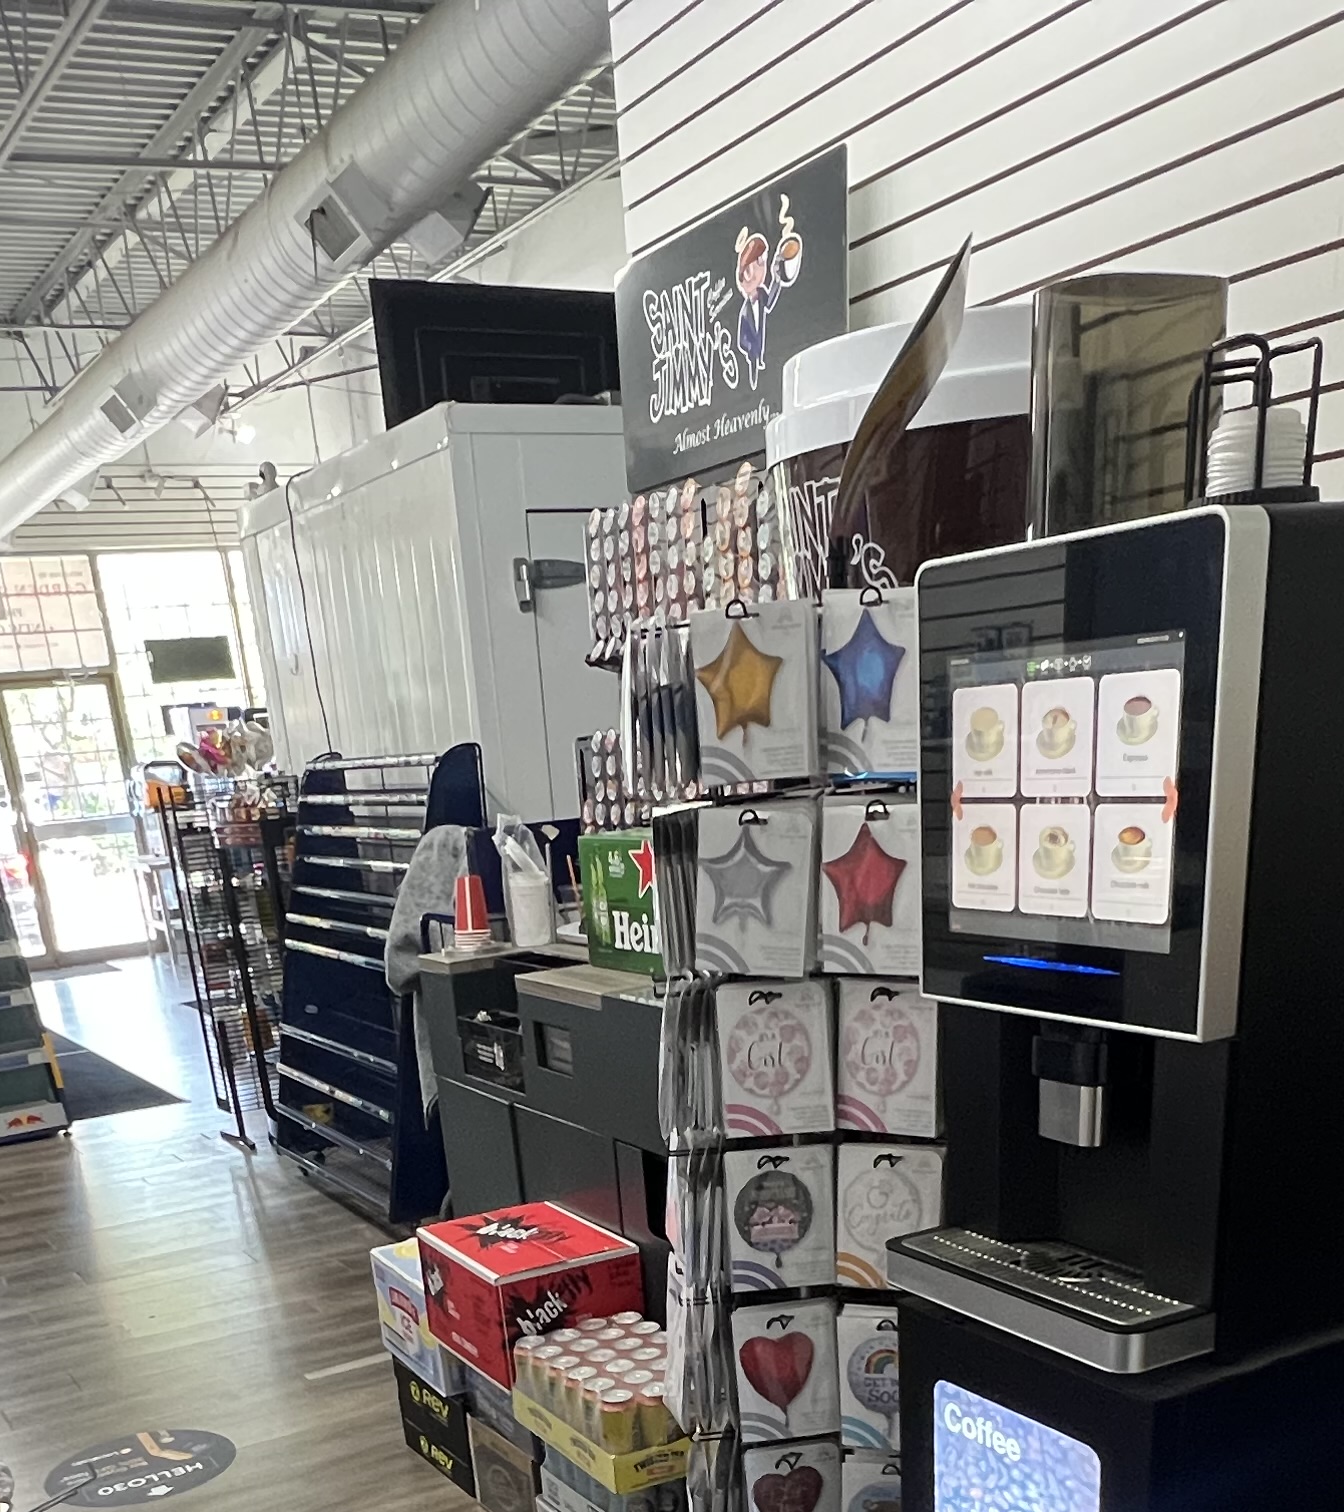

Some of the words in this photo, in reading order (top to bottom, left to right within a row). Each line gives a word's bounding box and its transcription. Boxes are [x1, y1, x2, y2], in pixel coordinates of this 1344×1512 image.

[643, 270, 711, 359] SAINT
[650, 321, 739, 423] JIMMY'S
[673, 425, 711, 455] Almost
[943, 1402, 1021, 1461] Coffee
[97, 1462, 203, 1496] HELLO30
